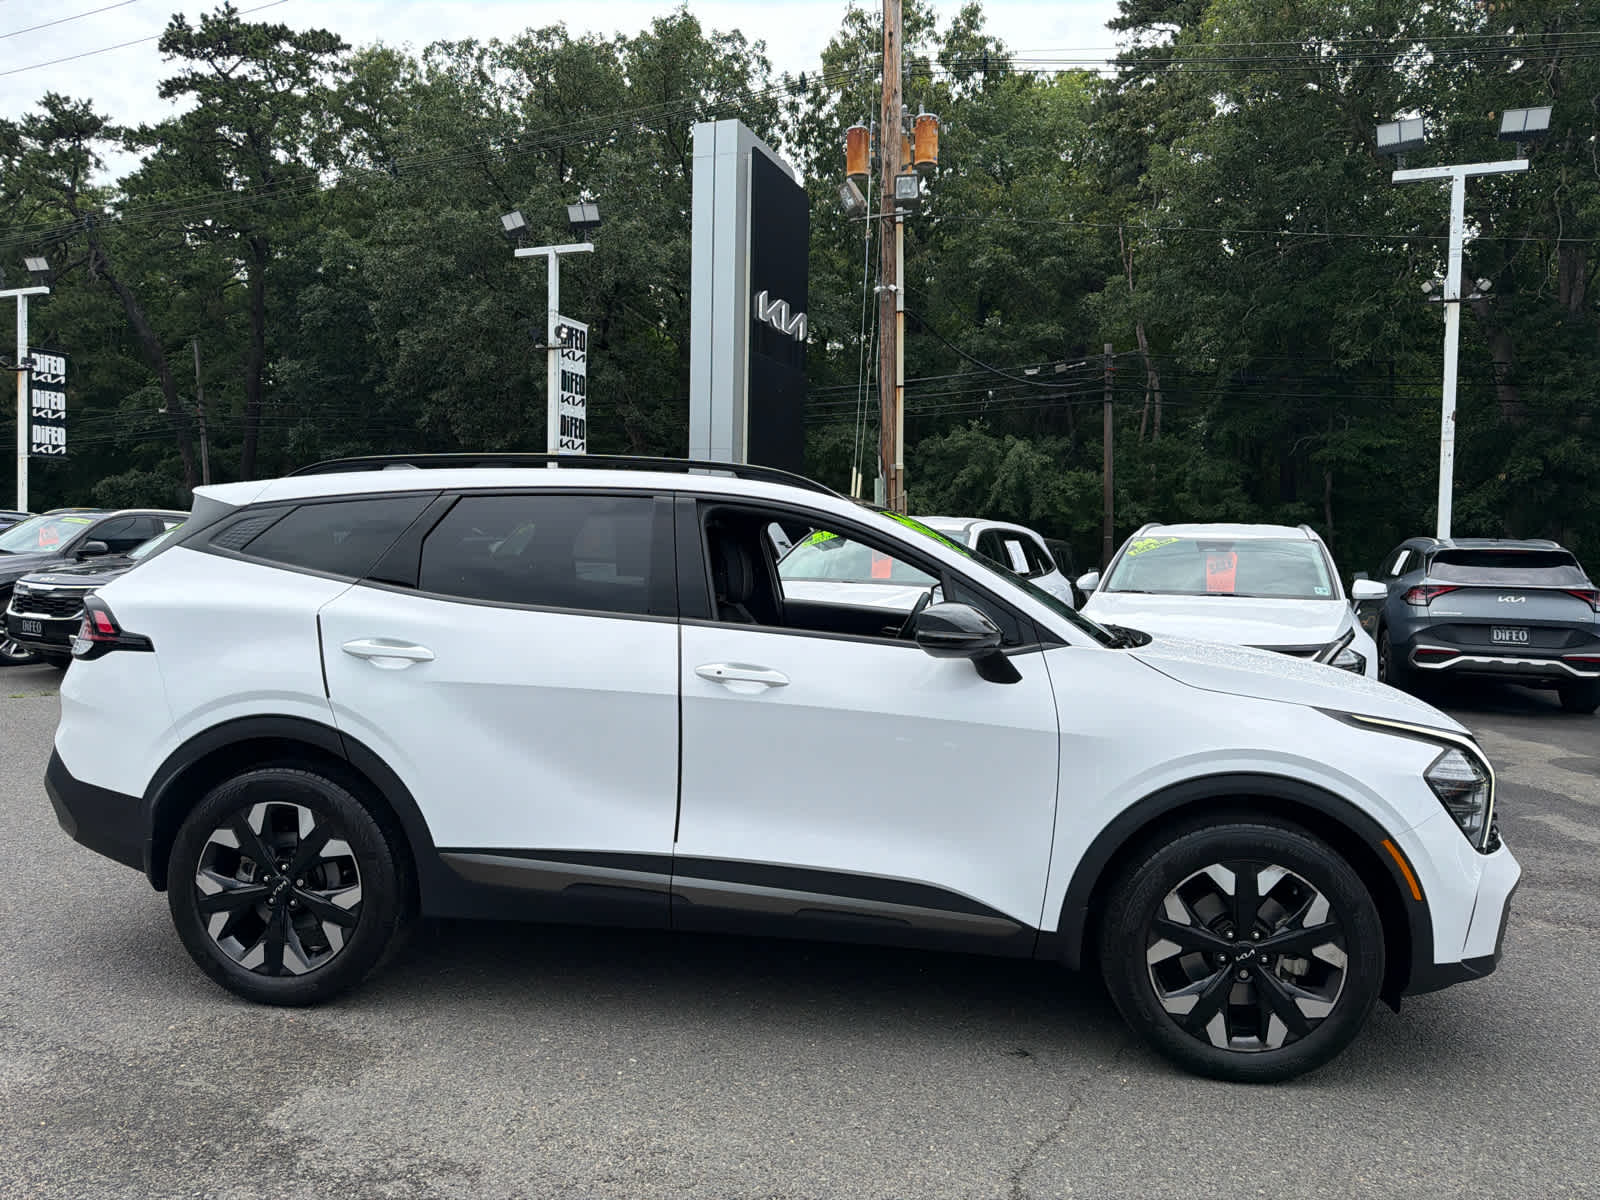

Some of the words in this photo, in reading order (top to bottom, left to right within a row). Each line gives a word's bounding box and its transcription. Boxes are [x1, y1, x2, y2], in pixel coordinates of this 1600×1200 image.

[755, 290, 808, 341] KIA
[561, 347, 585, 363] KIA
[32, 372, 66, 384] KIA
[561, 393, 585, 408] KIA
[32, 408, 66, 420] KIA
[32, 443, 66, 455] KIA
[559, 438, 585, 451] KIA
[1497, 595, 1526, 604] KIA
[1493, 629, 1528, 642] DiFEO
